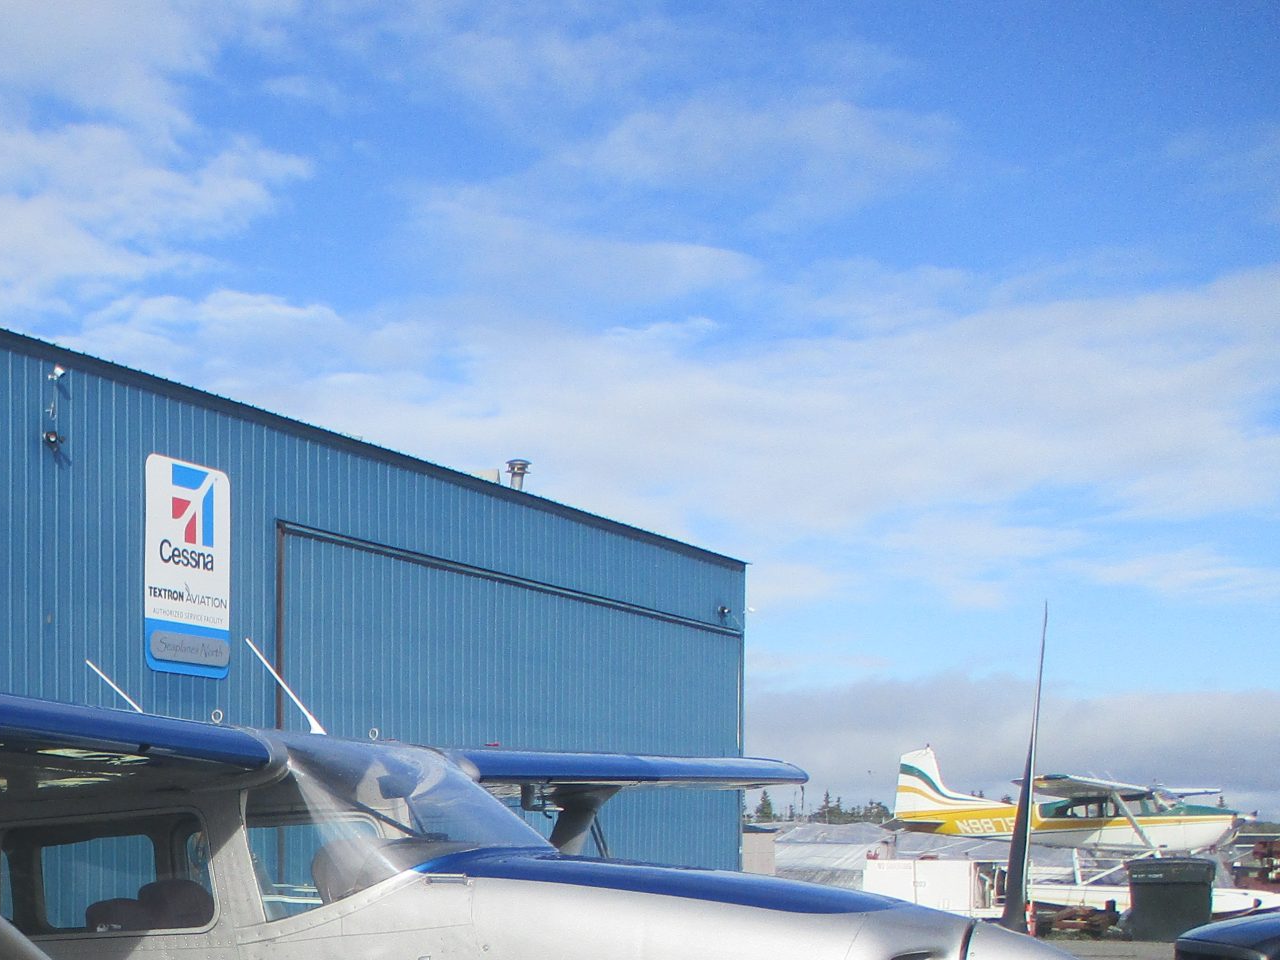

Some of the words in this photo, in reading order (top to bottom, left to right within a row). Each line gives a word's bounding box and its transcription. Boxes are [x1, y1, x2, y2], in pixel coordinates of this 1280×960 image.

[159, 538, 214, 572] Cessna
[148, 586, 184, 602] TEXTRON
[185, 591, 228, 609] AVIATION
[152, 607, 183, 619] AUTHORIZED
[184, 611, 203, 622] SERVICE
[204, 614, 224, 625] FACILITY
[200, 642, 223, 658] North
